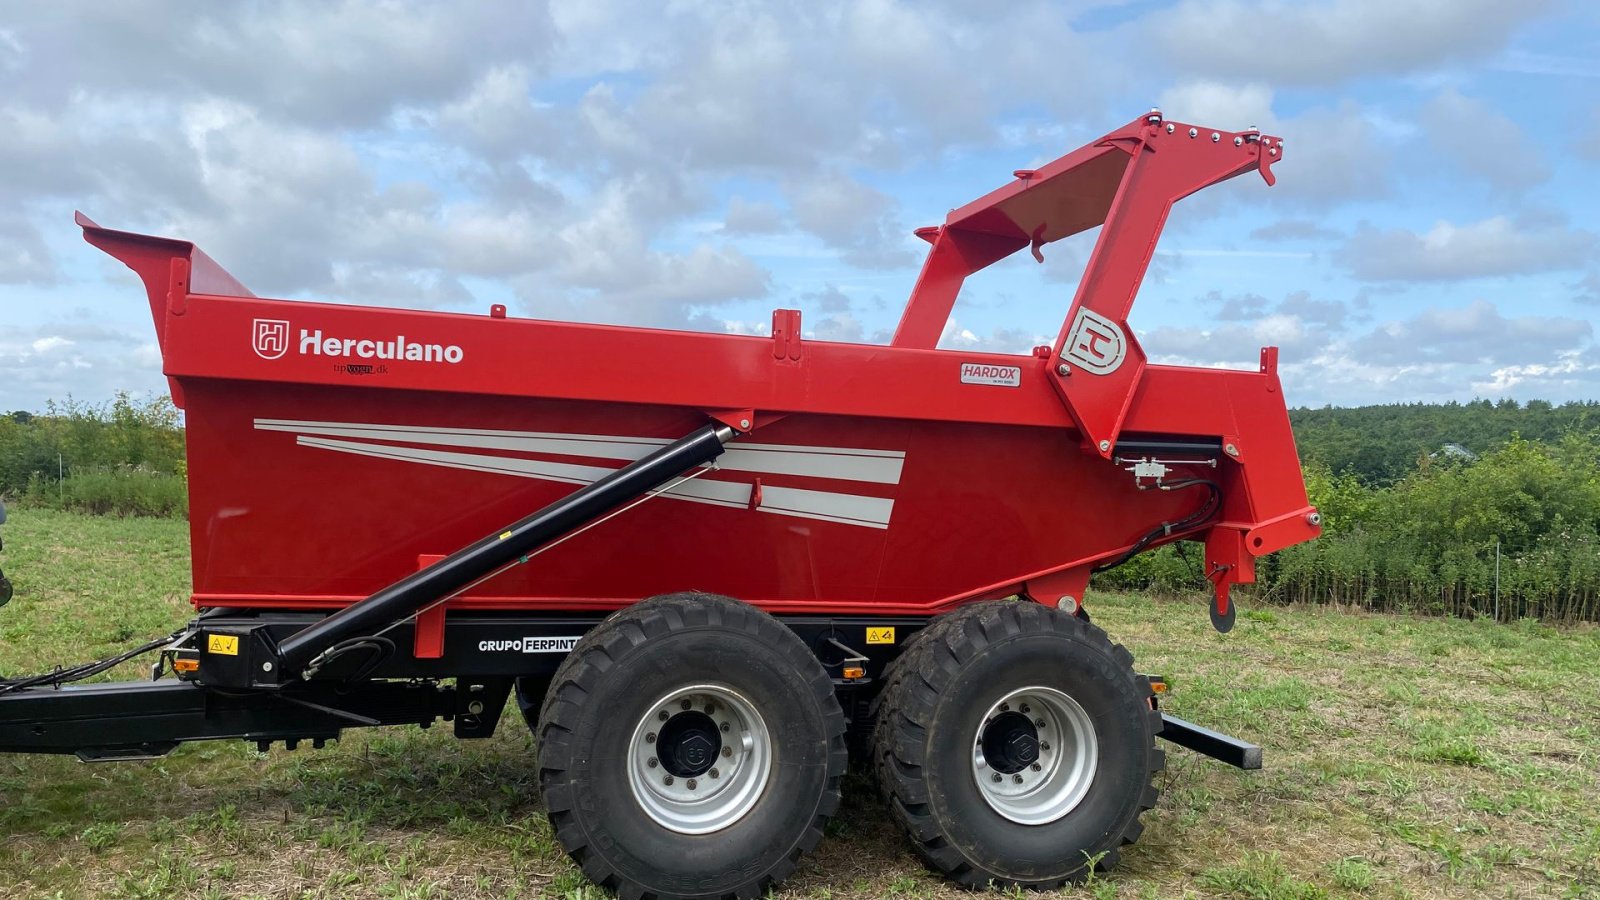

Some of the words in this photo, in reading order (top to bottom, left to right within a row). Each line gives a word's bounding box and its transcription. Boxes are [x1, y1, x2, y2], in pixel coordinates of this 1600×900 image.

[300, 329, 464, 363] Herculano
[963, 365, 1016, 380] HARDOX
[478, 640, 522, 652] GRUPO
[525, 639, 579, 651] FERPINT
